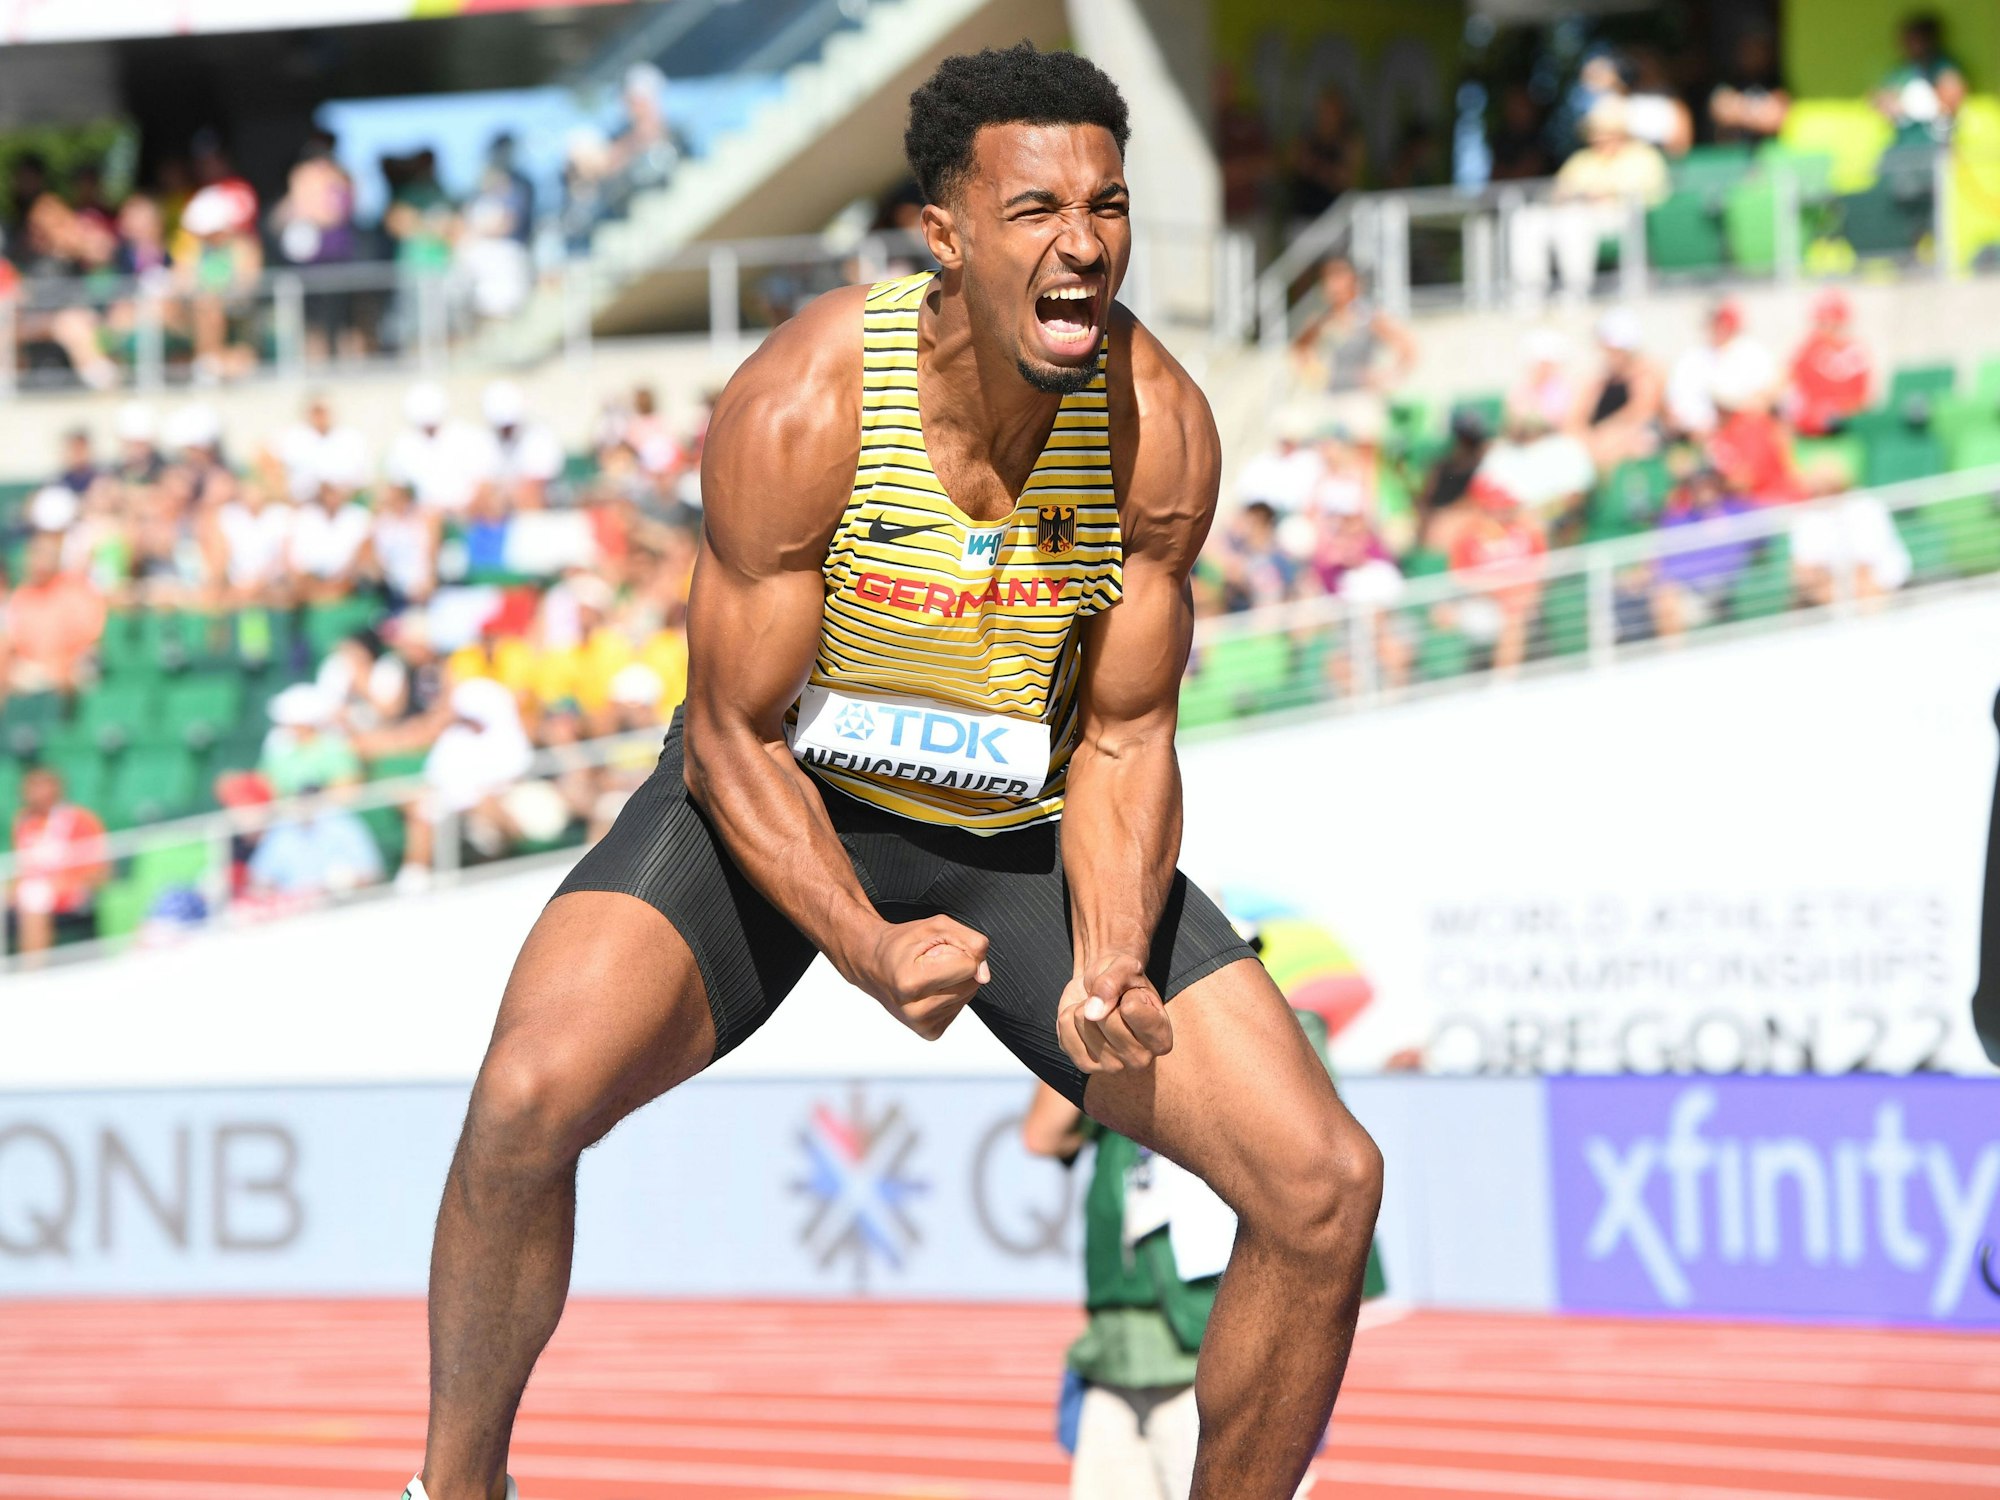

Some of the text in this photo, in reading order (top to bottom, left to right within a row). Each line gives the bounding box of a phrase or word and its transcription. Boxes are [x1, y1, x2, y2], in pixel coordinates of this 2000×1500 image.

[854, 572, 1069, 618] GERMANY
[878, 705, 1010, 764] TDK
[0, 1121, 307, 1258] QNB
[1582, 1085, 2000, 1317] xfinity
